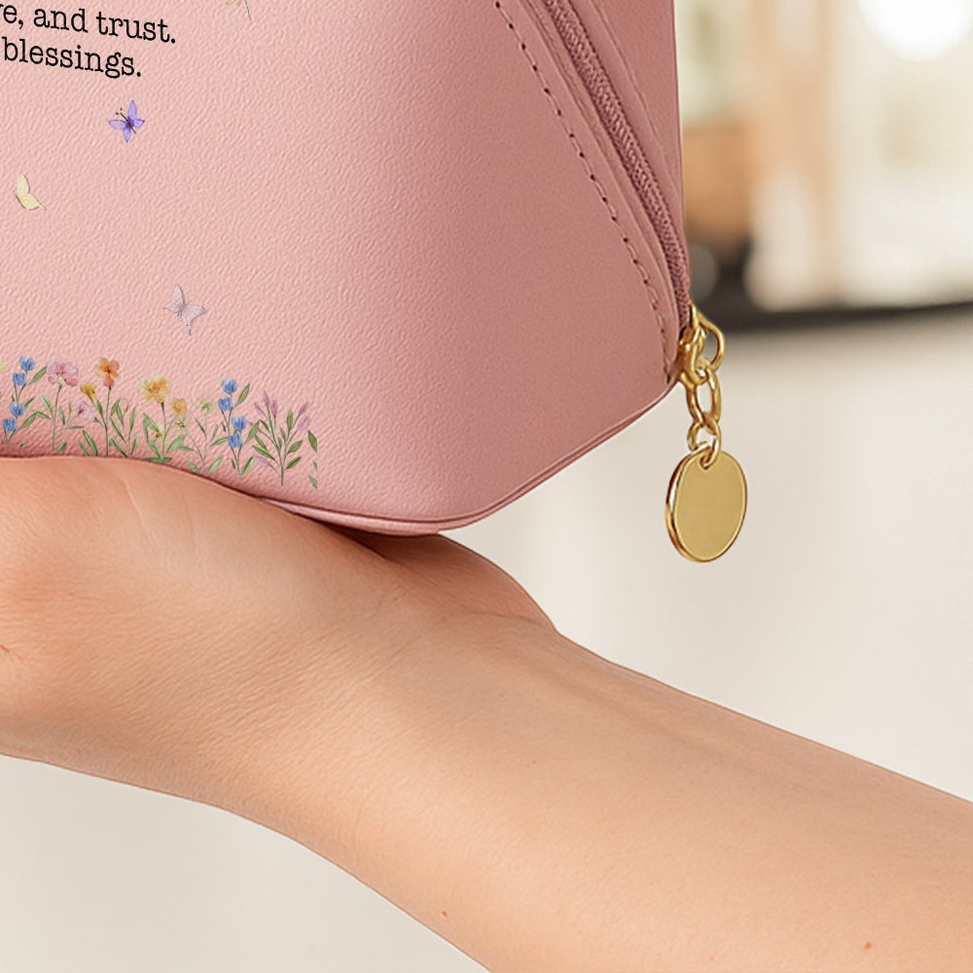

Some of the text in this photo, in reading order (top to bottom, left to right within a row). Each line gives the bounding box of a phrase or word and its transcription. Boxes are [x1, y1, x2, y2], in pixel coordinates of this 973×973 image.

[33, 7, 89, 34] and
[95, 11, 176, 44] trust.
[1, 35, 142, 80] blessings.
